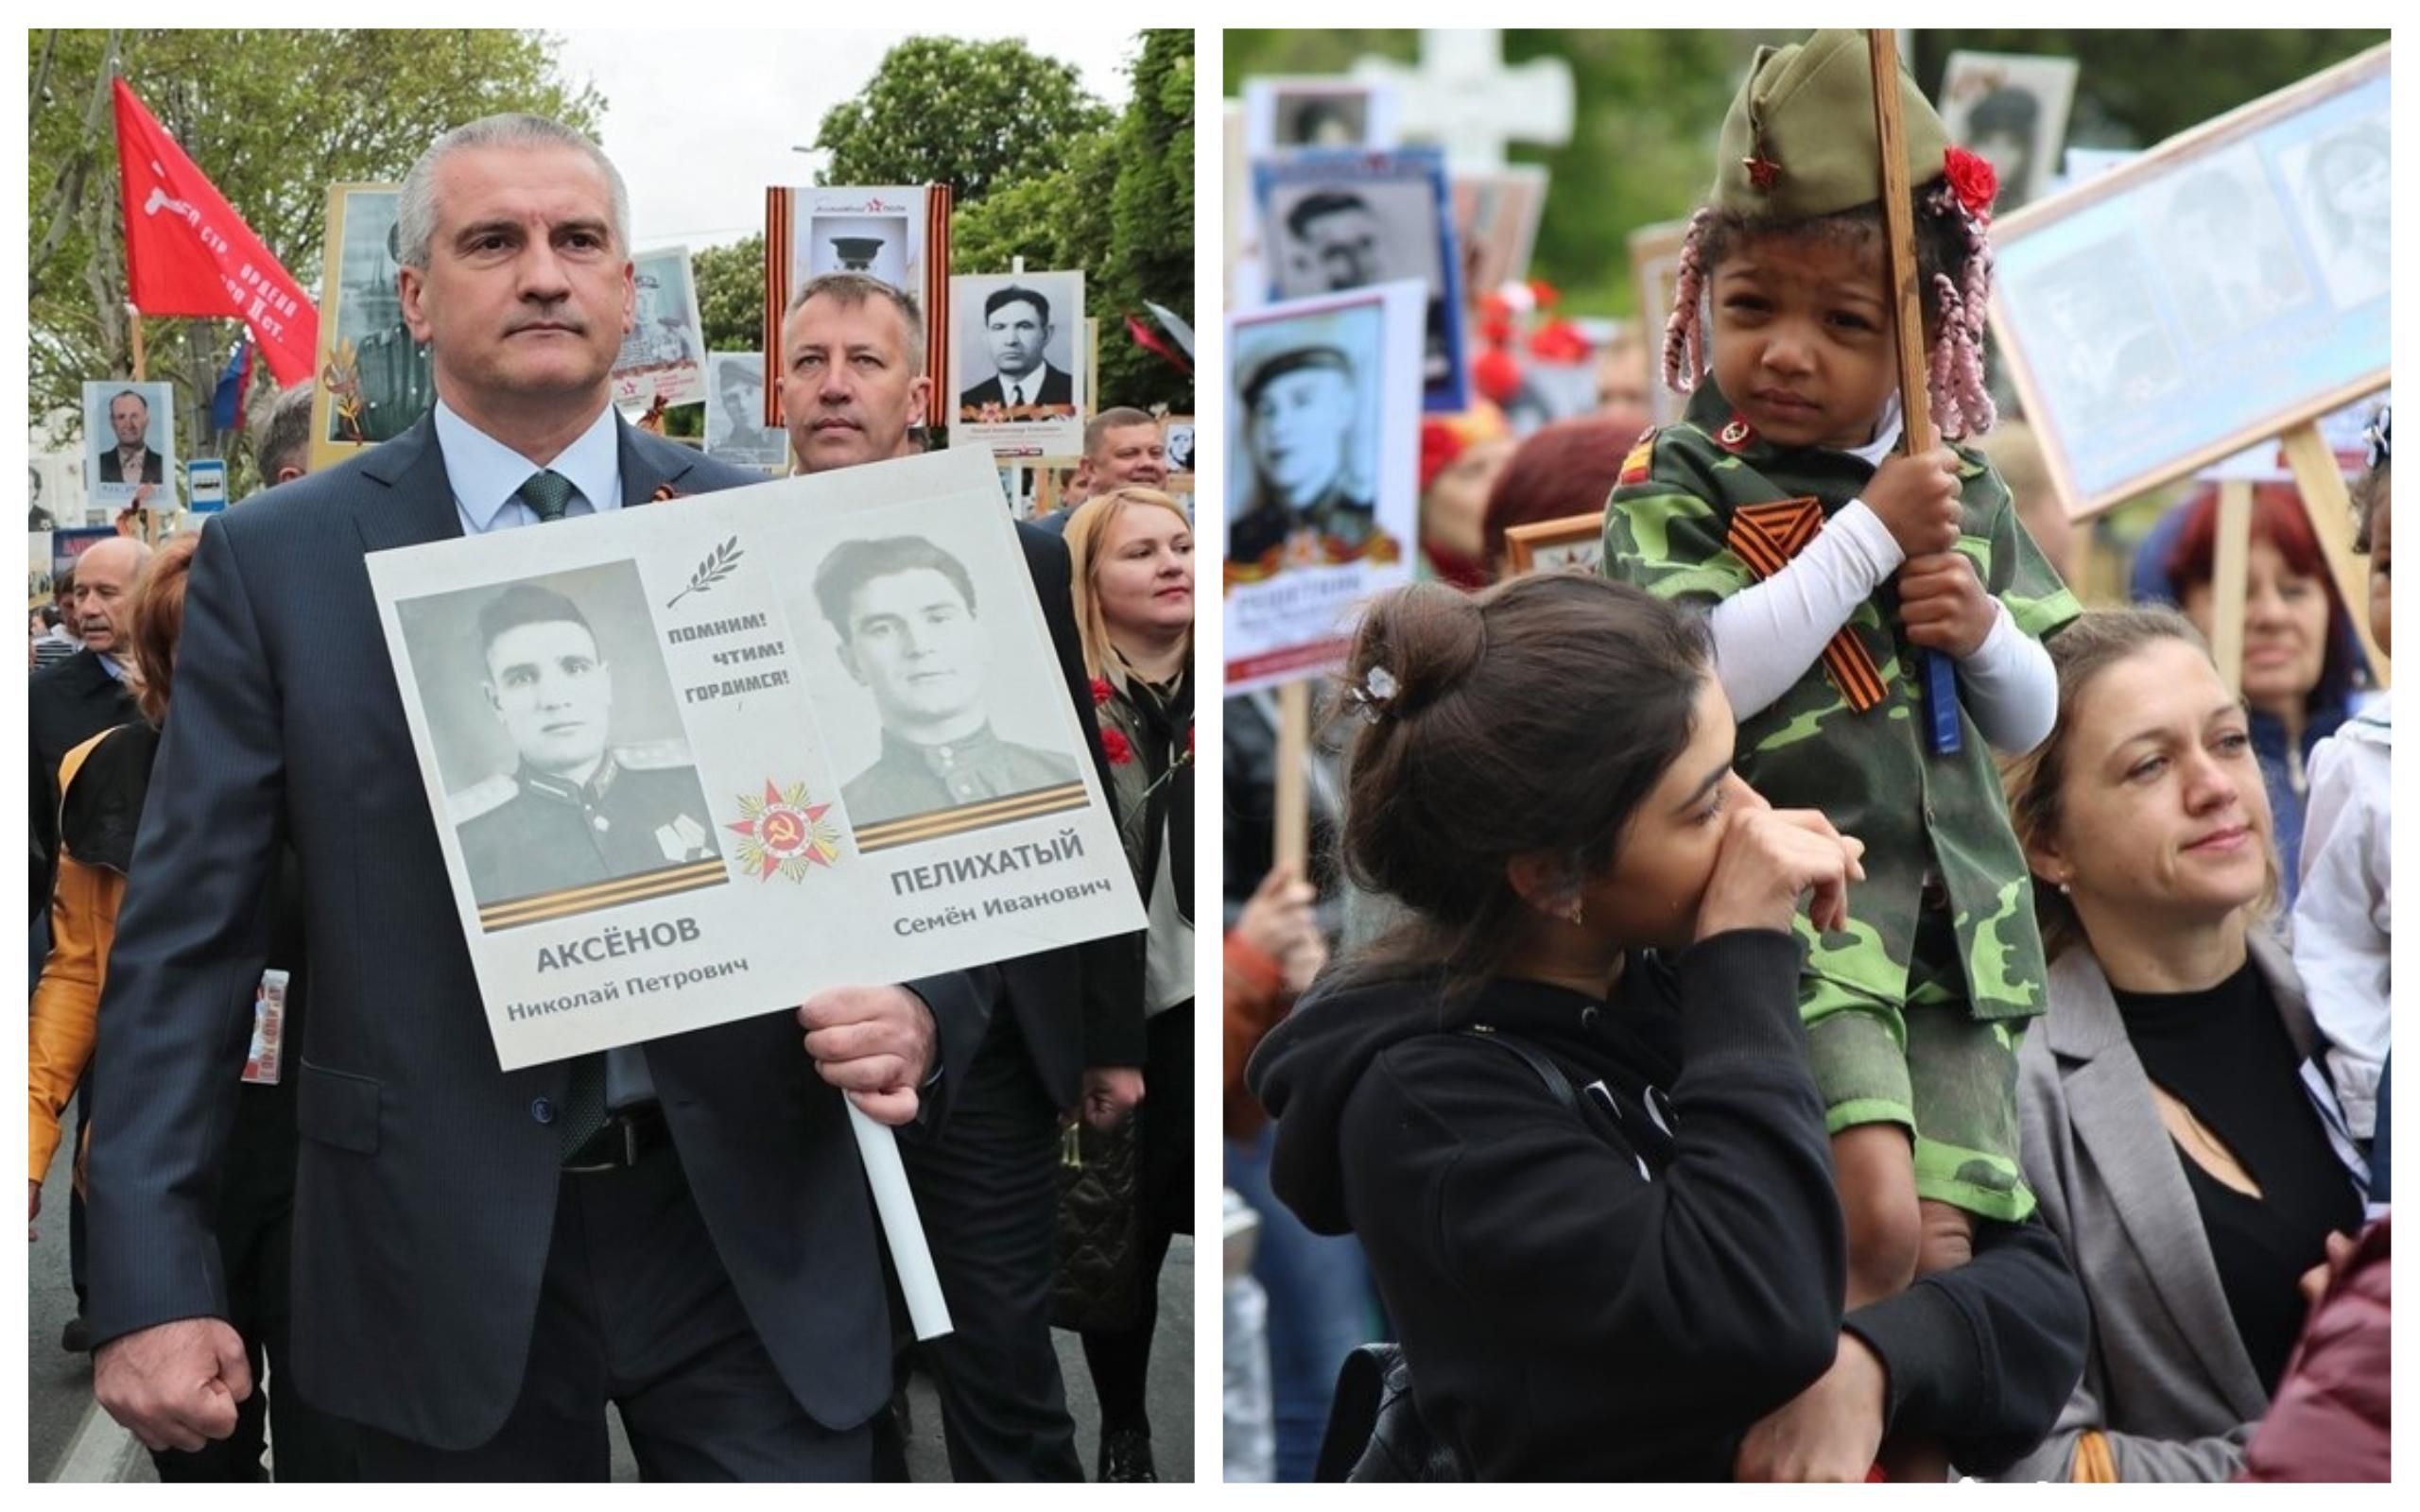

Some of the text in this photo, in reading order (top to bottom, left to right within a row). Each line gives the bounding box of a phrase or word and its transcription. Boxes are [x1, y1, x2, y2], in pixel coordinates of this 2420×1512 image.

[666, 611, 768, 644] ПОМНИМ!
[712, 641, 786, 665] ЧТИМ!
[684, 669, 790, 704] ГОРДИМСЯ!
[890, 828, 1085, 896] ПЕЛИХАТЫЙ
[892, 878, 1112, 937] Семён Иванович
[537, 917, 700, 973] АКСЁНОВ
[506, 957, 750, 1022] Николай Петрович
